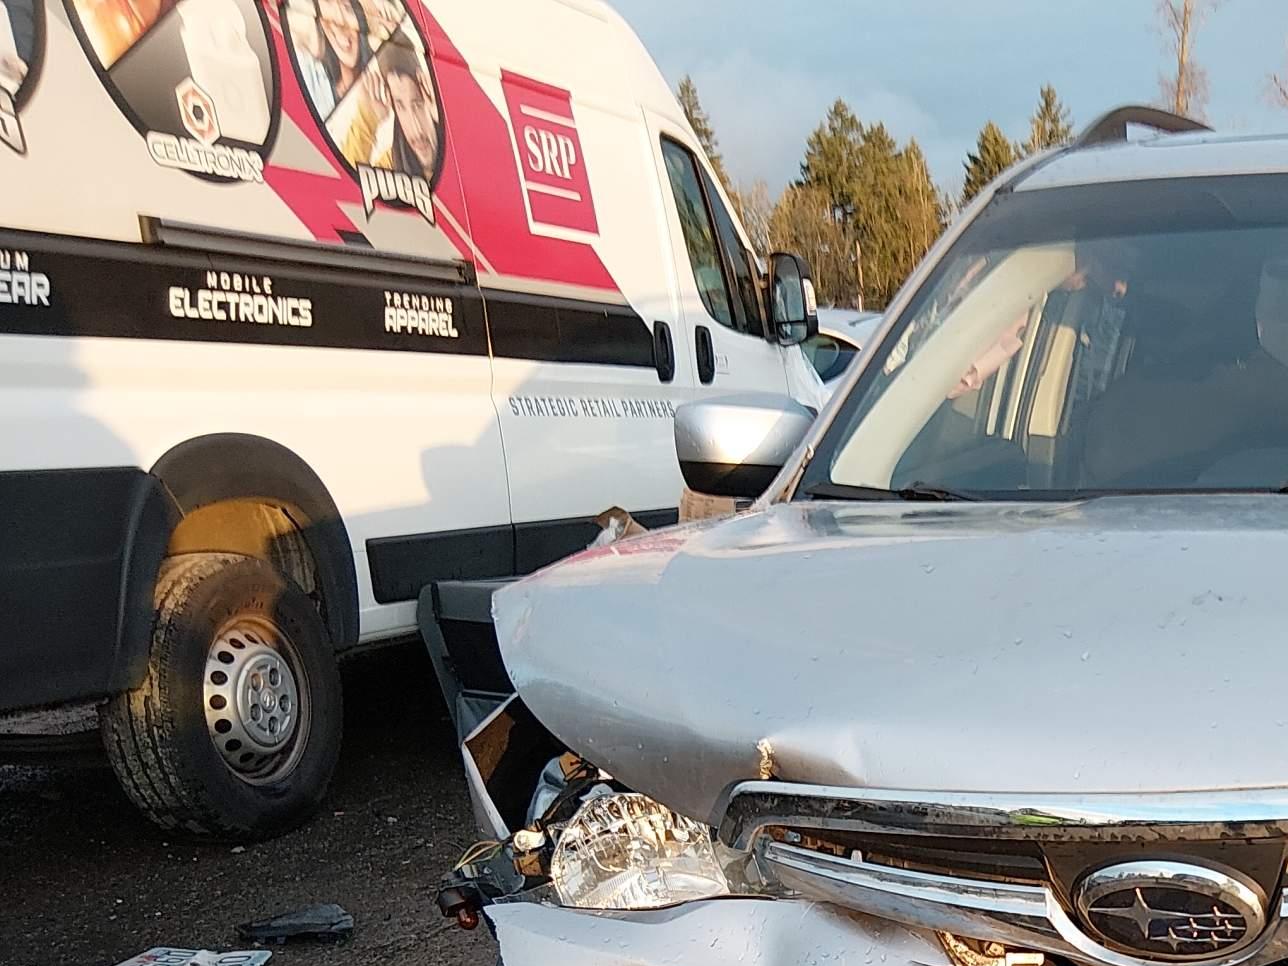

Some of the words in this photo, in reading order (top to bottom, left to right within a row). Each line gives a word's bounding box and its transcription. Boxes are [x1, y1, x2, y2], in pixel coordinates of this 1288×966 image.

[524, 125, 577, 180] SRP
[206, 270, 273, 295] MOBILE
[168, 286, 313, 327] ELECTRONICS
[384, 290, 454, 314] TRENDING
[384, 306, 459, 338] APPAREL
[508, 397, 578, 417] STRATEGIC
[580, 399, 621, 418] RETAIL
[621, 400, 675, 418] PARTNERS
